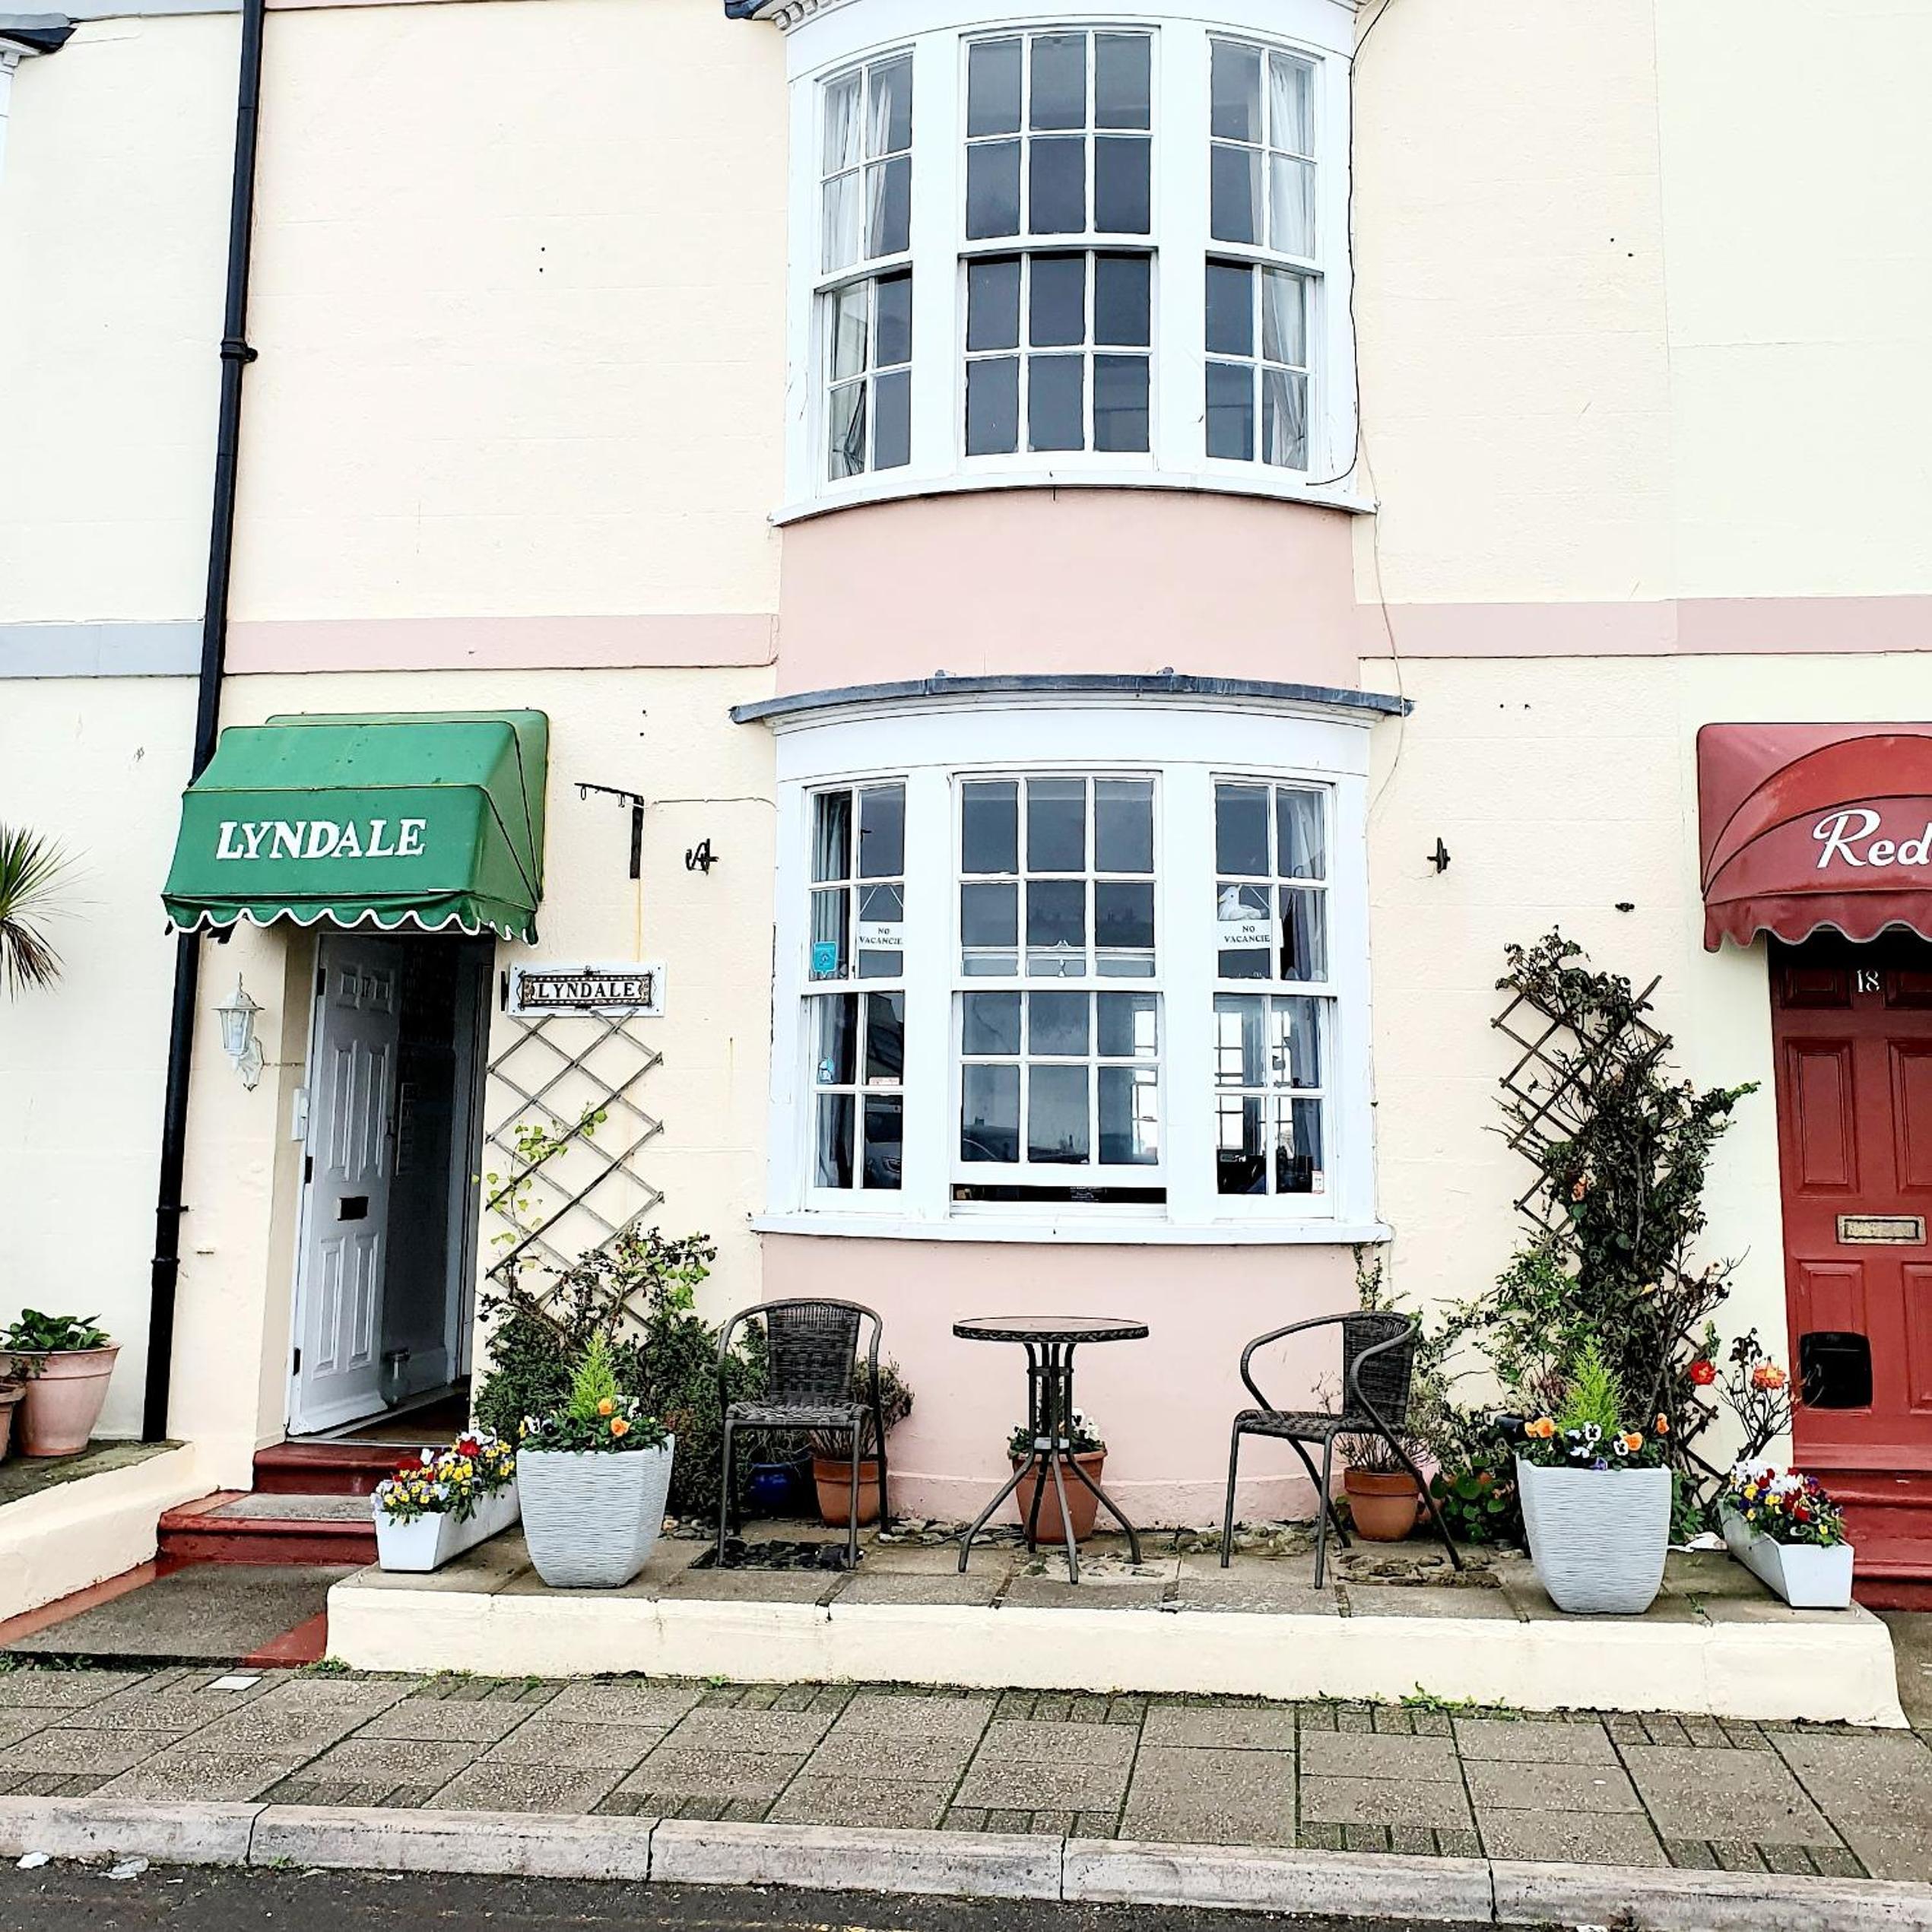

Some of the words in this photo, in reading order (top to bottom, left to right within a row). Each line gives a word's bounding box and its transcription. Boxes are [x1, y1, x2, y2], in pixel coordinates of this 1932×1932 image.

[216, 819, 427, 859] LYNDALE
[538, 982, 635, 998] LYNDALE
[1857, 969, 1880, 992] 18
